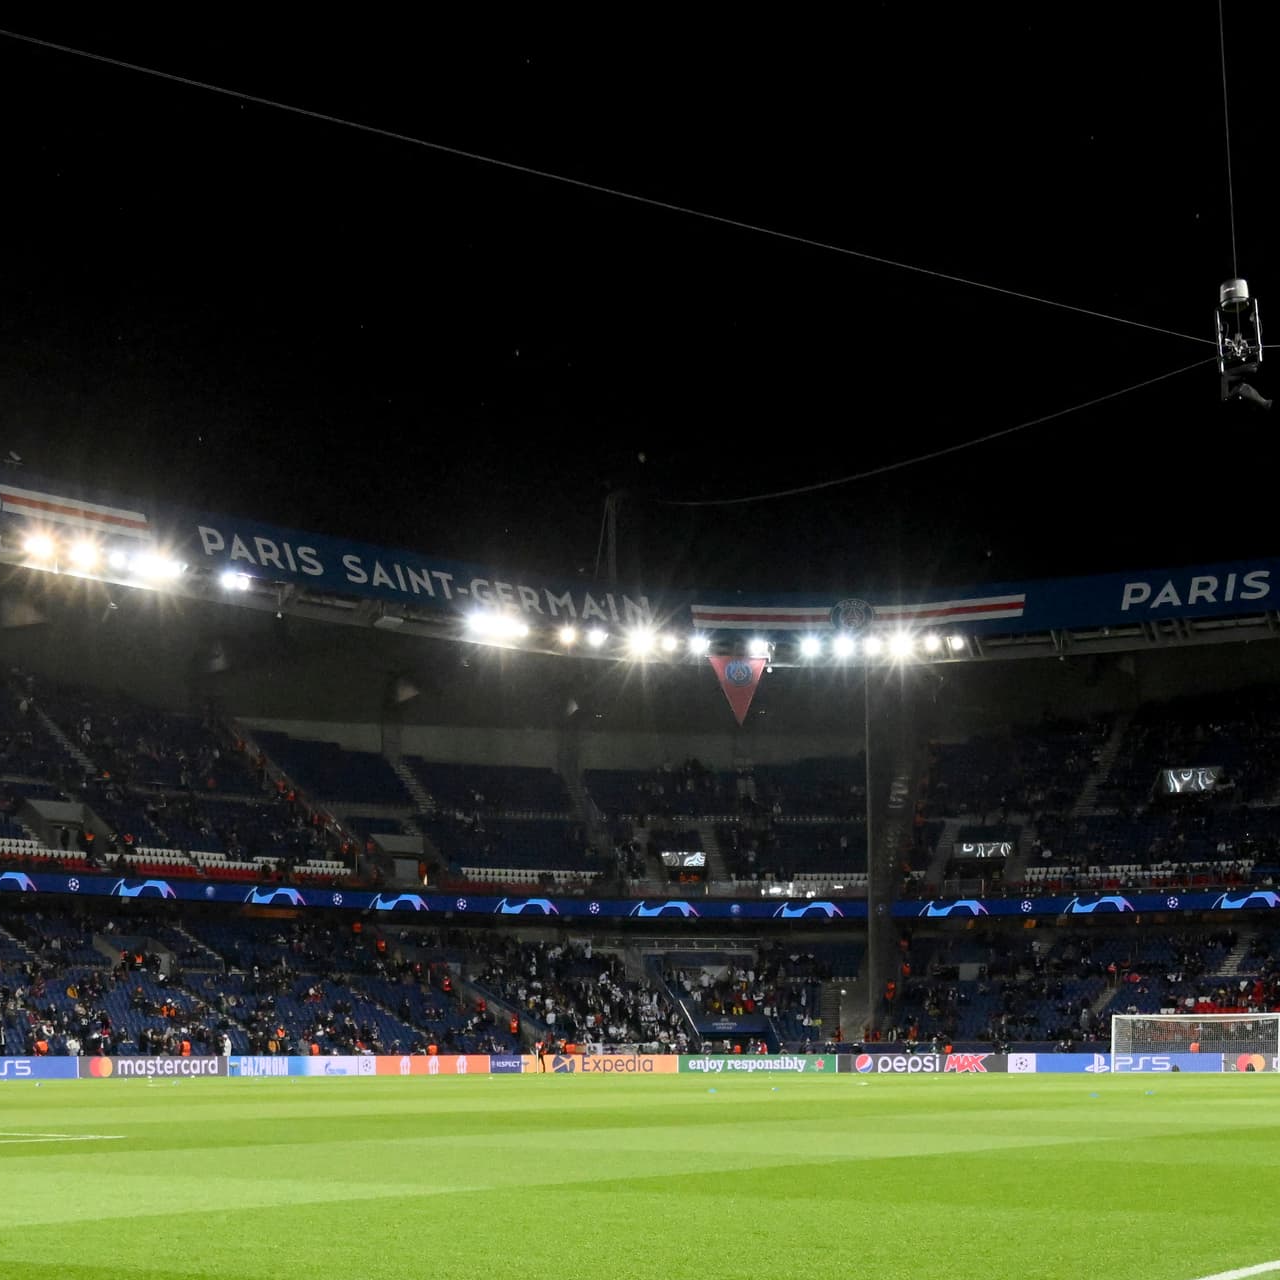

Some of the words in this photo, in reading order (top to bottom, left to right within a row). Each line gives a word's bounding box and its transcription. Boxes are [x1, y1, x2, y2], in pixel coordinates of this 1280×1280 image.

[197, 525, 323, 577] PARIS
[342, 553, 651, 624] SAINT-GERMAIN
[1121, 570, 1270, 611] PARIS
[117, 1056, 219, 1075] mastercard
[241, 1056, 289, 1076] GAZPROM
[582, 1055, 654, 1074] Expedia
[688, 1058, 725, 1073] enjoy
[727, 1056, 806, 1073] responsibly
[877, 1054, 940, 1073] pepsi
[943, 1054, 989, 1073] MAX
[1115, 1056, 1171, 1072] PS5
